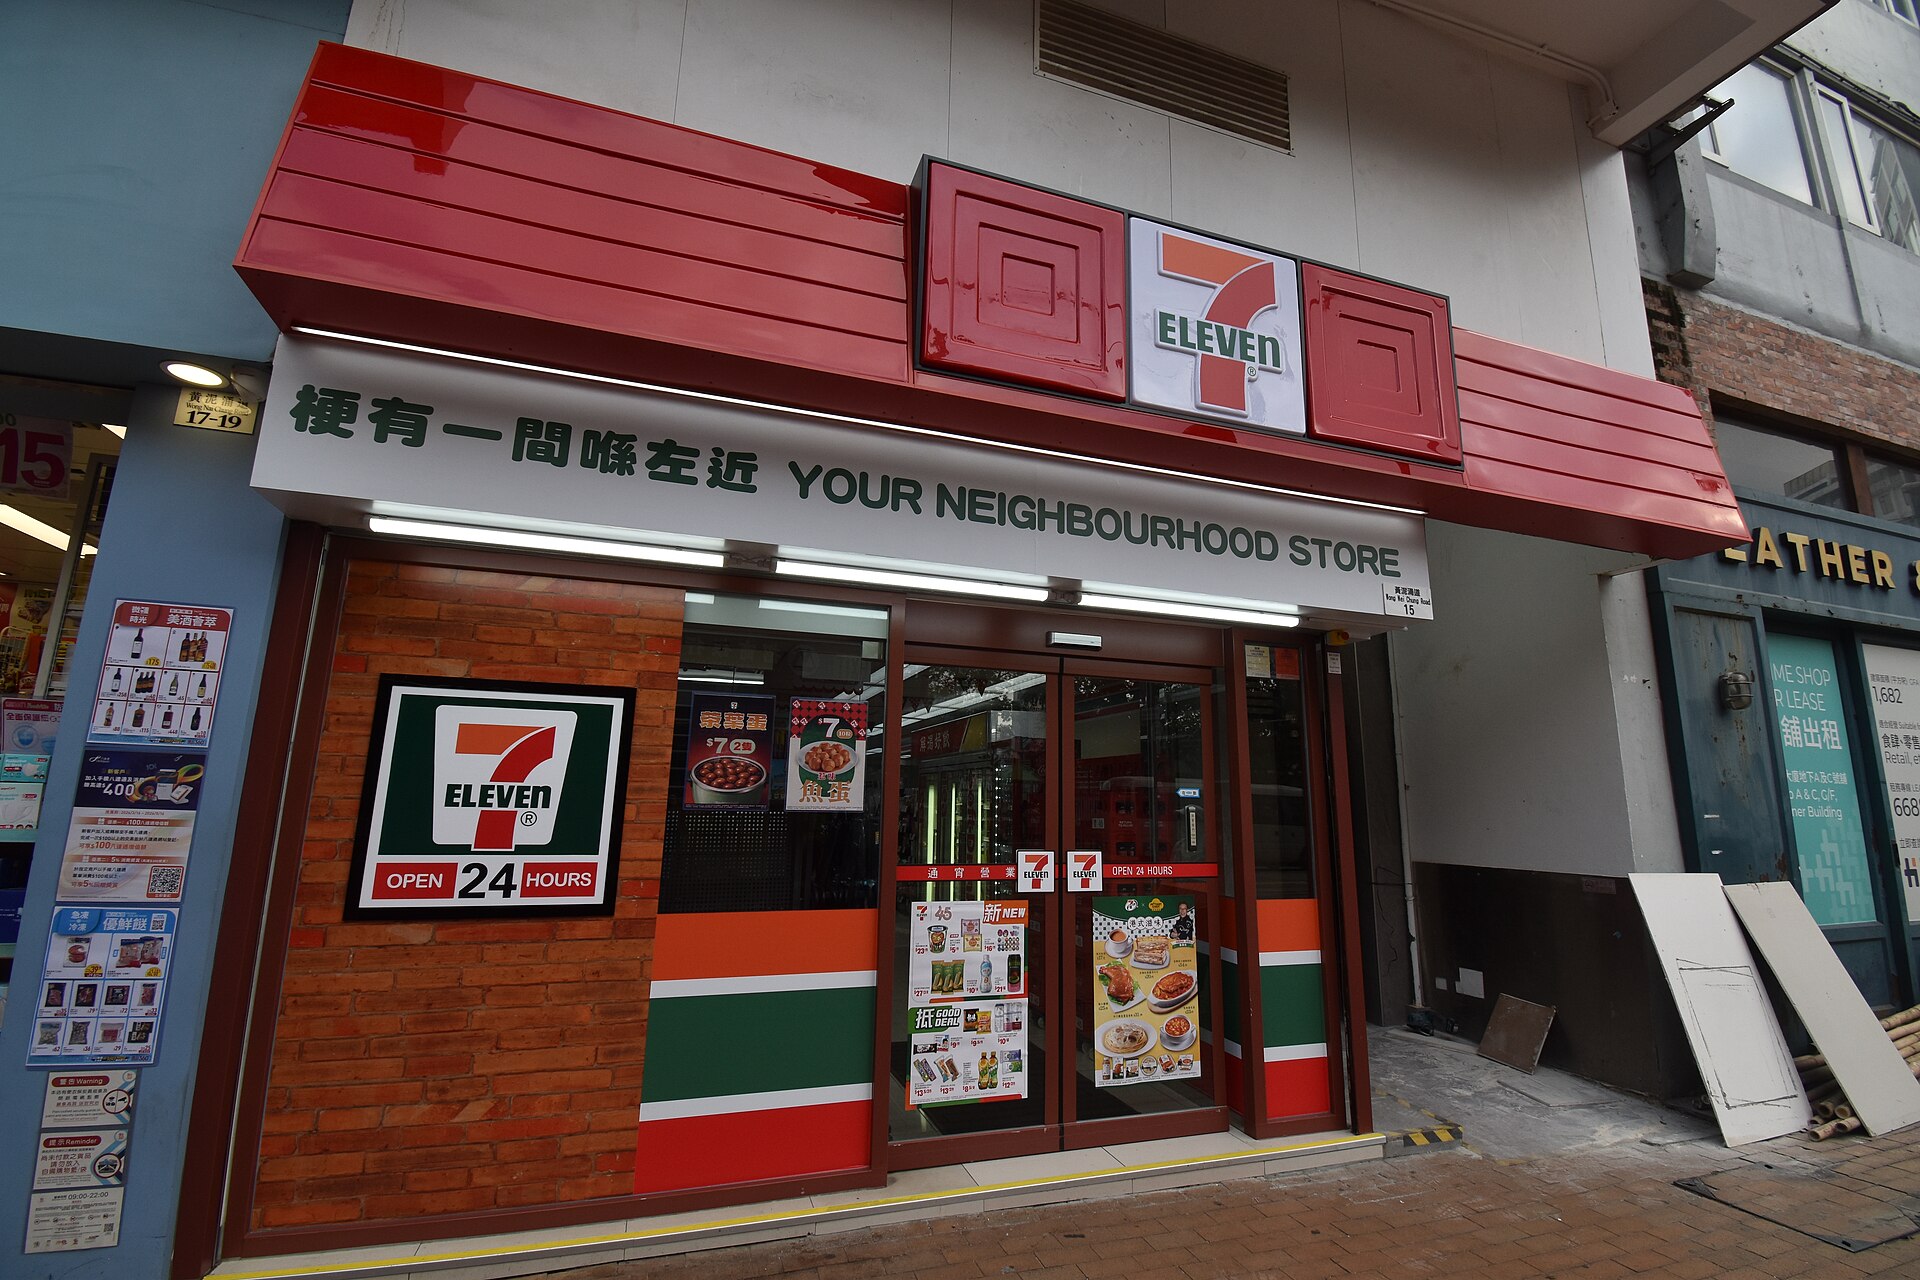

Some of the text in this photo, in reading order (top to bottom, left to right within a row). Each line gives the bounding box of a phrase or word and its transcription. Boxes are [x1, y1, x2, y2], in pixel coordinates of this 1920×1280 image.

[186, 411, 241, 428] 17-19
[289, 384, 759, 494] 梗有一間喺左近
[788, 460, 1402, 578] YOUR NEIGHBOURHOOD STORE
[1724, 527, 1896, 589] ATHER
[1404, 604, 1414, 615] 15
[1795, 666, 1831, 687] SHOP
[1786, 690, 1826, 711] LEASE
[1872, 686, 1903, 705] 1,682
[818, 718, 840, 738] $7
[706, 738, 728, 754] $7
[1885, 751, 1912, 766] Retail,
[455, 723, 556, 849] 7
[799, 779, 851, 803] 魚蛋
[1796, 789, 1803, 800] A
[1807, 806, 1843, 821] Building
[386, 862, 591, 898] OPEN 24 HOURS
[928, 867, 1015, 879] 通宵營業
[1112, 865, 1173, 876] OPEN 24 HOURS
[983, 904, 1026, 923] 新 NEW
[915, 1008, 935, 1028] 抵
[935, 1017, 959, 1027] DEAL
[936, 1008, 960, 1017] GOOD
[68, 1192, 109, 1200] 09:00-22:00
